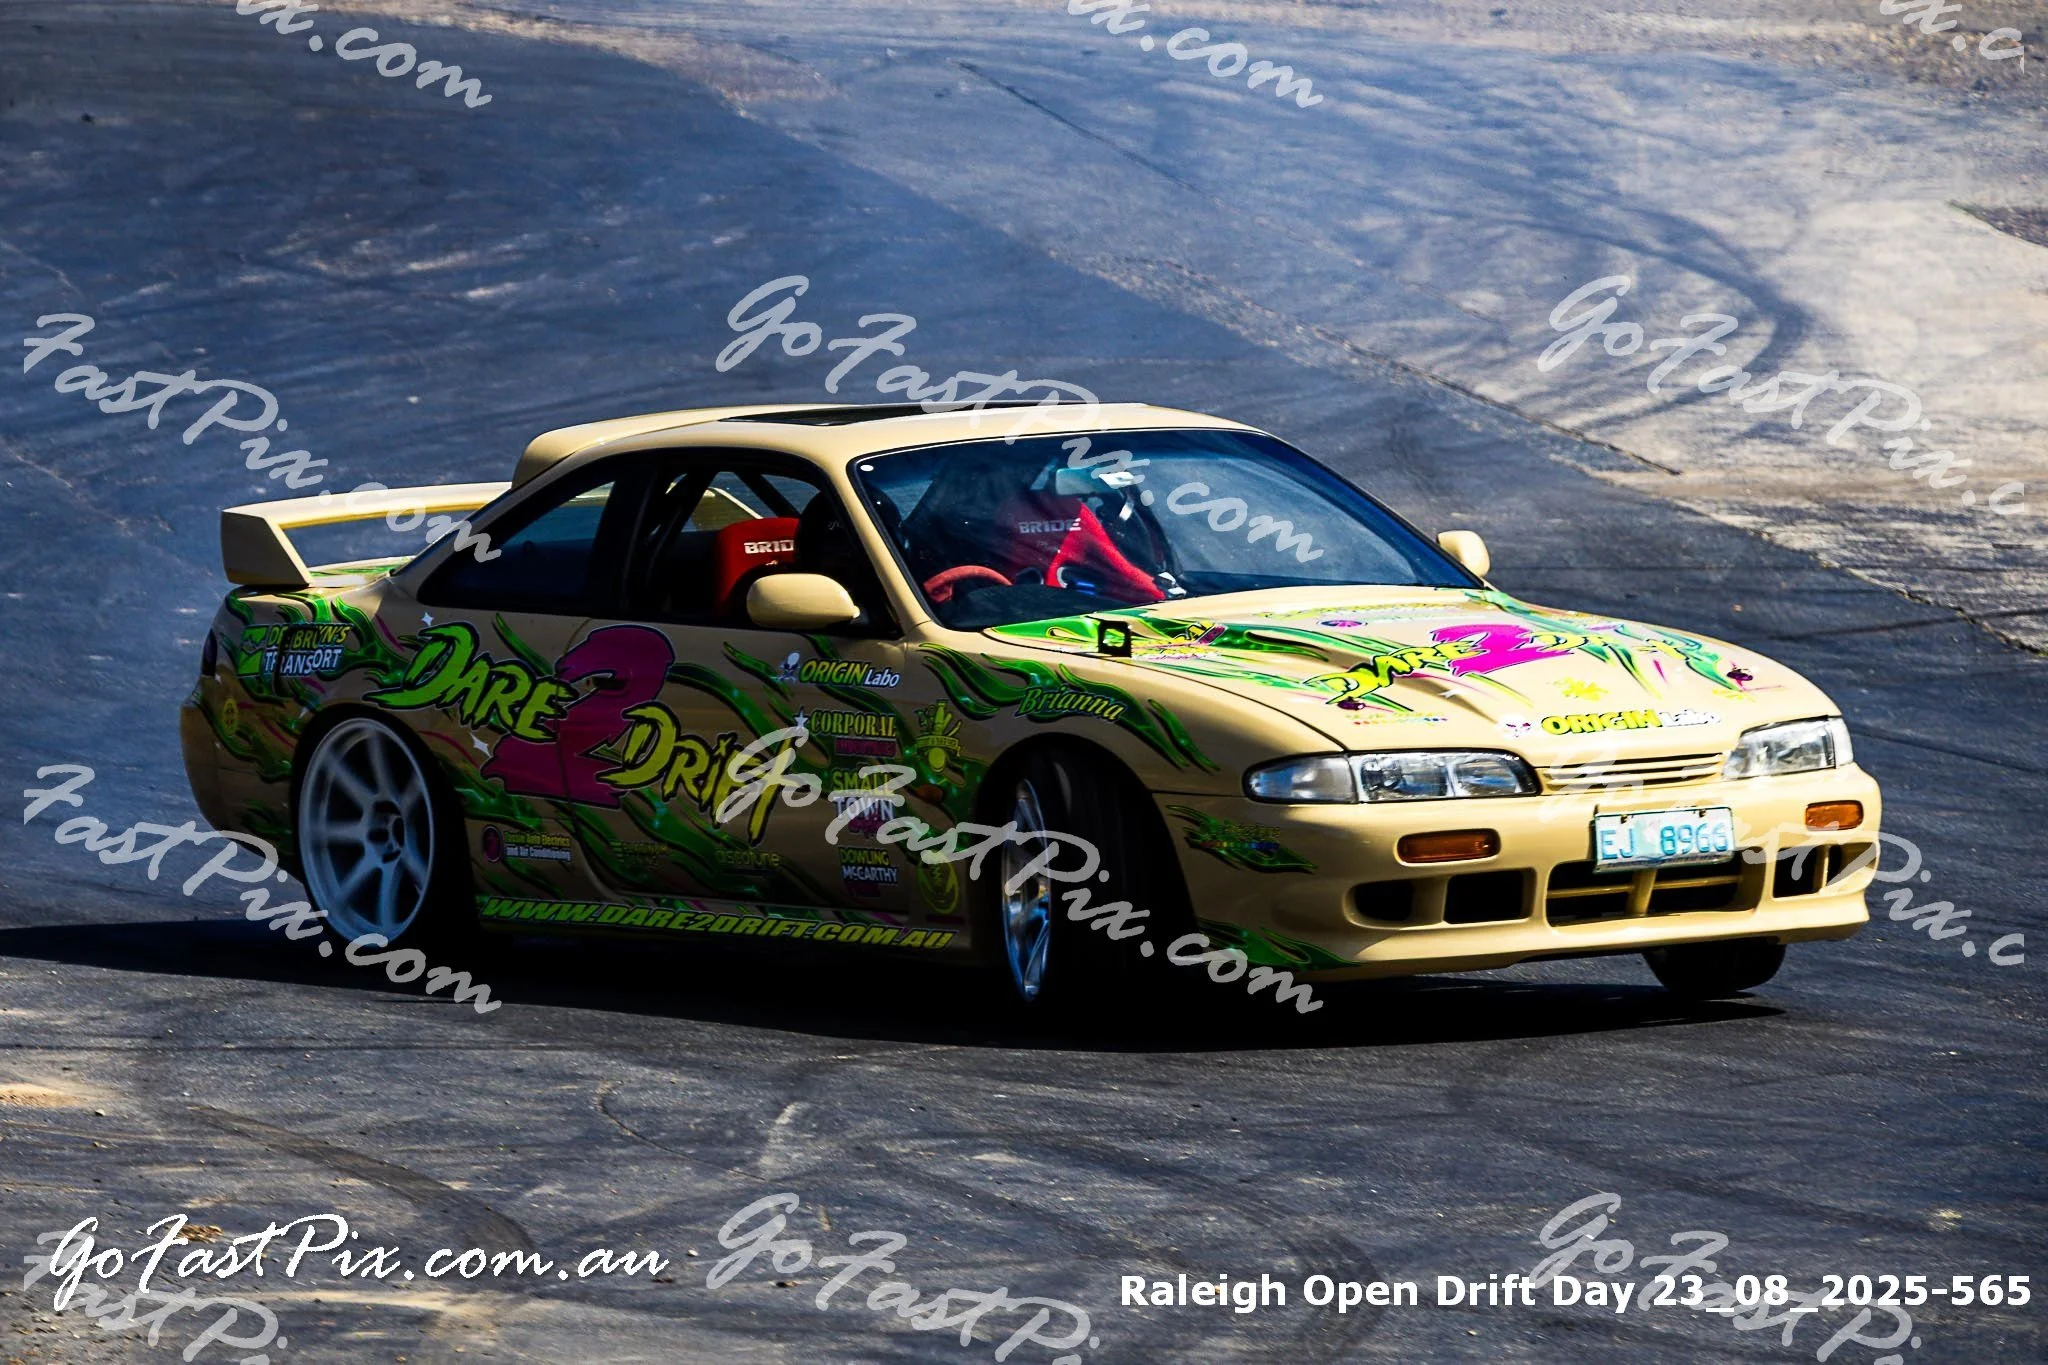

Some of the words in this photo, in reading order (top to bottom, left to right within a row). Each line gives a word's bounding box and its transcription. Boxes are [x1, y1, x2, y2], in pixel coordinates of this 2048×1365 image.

[1018, 518, 1081, 535] BRIDE
[744, 540, 794, 555] BRID
[1430, 624, 1574, 677] 2
[800, 659, 868, 686] ORIGIN
[864, 667, 900, 687] Labo
[364, 622, 578, 742] DARE
[481, 624, 675, 808] 2
[1015, 685, 1127, 722] Brianna
[810, 710, 897, 738] CORPORAL
[1541, 709, 1663, 735] ORIGIN
[833, 795, 896, 821] TOWN
[839, 847, 891, 866] DOWLING
[1600, 828, 1635, 860] EJ
[480, 897, 955, 950] WWW.DARE2DRIFT.COM.AU
